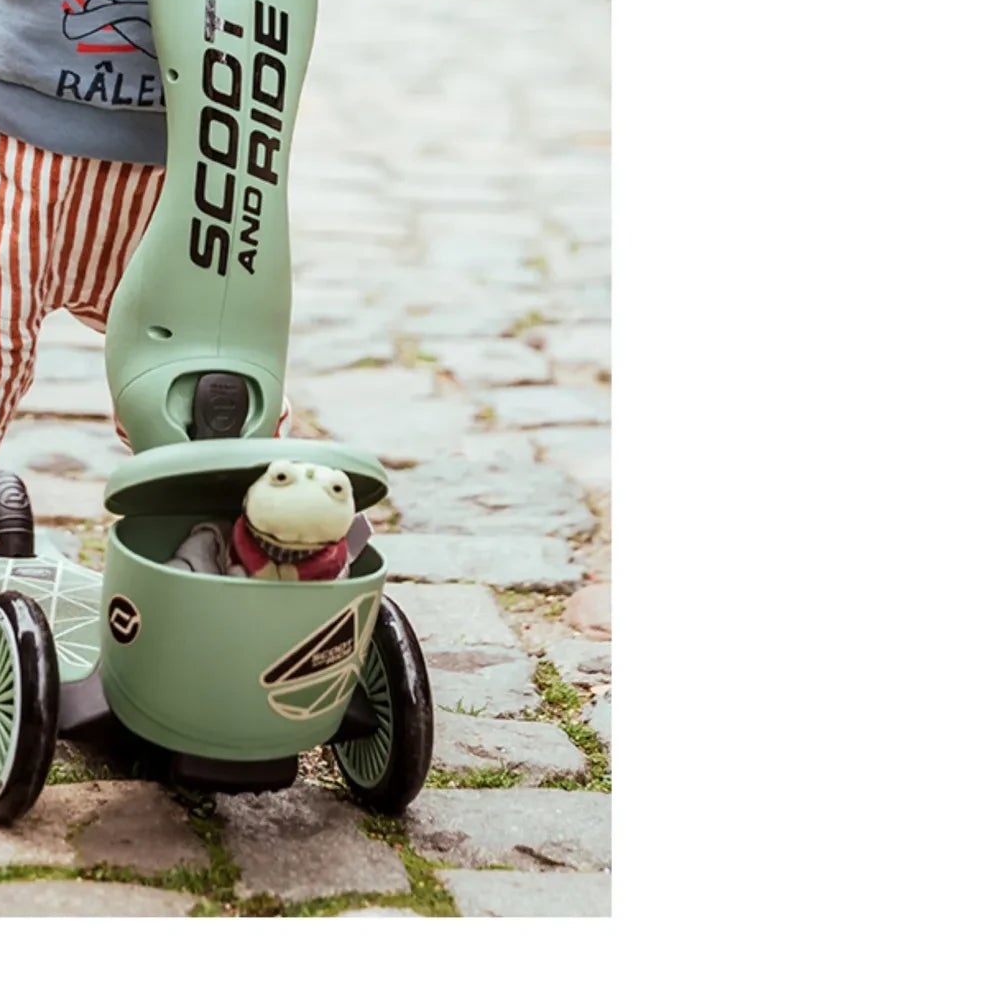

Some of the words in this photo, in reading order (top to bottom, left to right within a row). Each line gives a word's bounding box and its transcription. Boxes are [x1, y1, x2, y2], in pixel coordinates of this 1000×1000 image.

[56, 60, 166, 107] RÂLE
[247, 0, 289, 186] RIDE
[238, 186, 263, 275] AND
